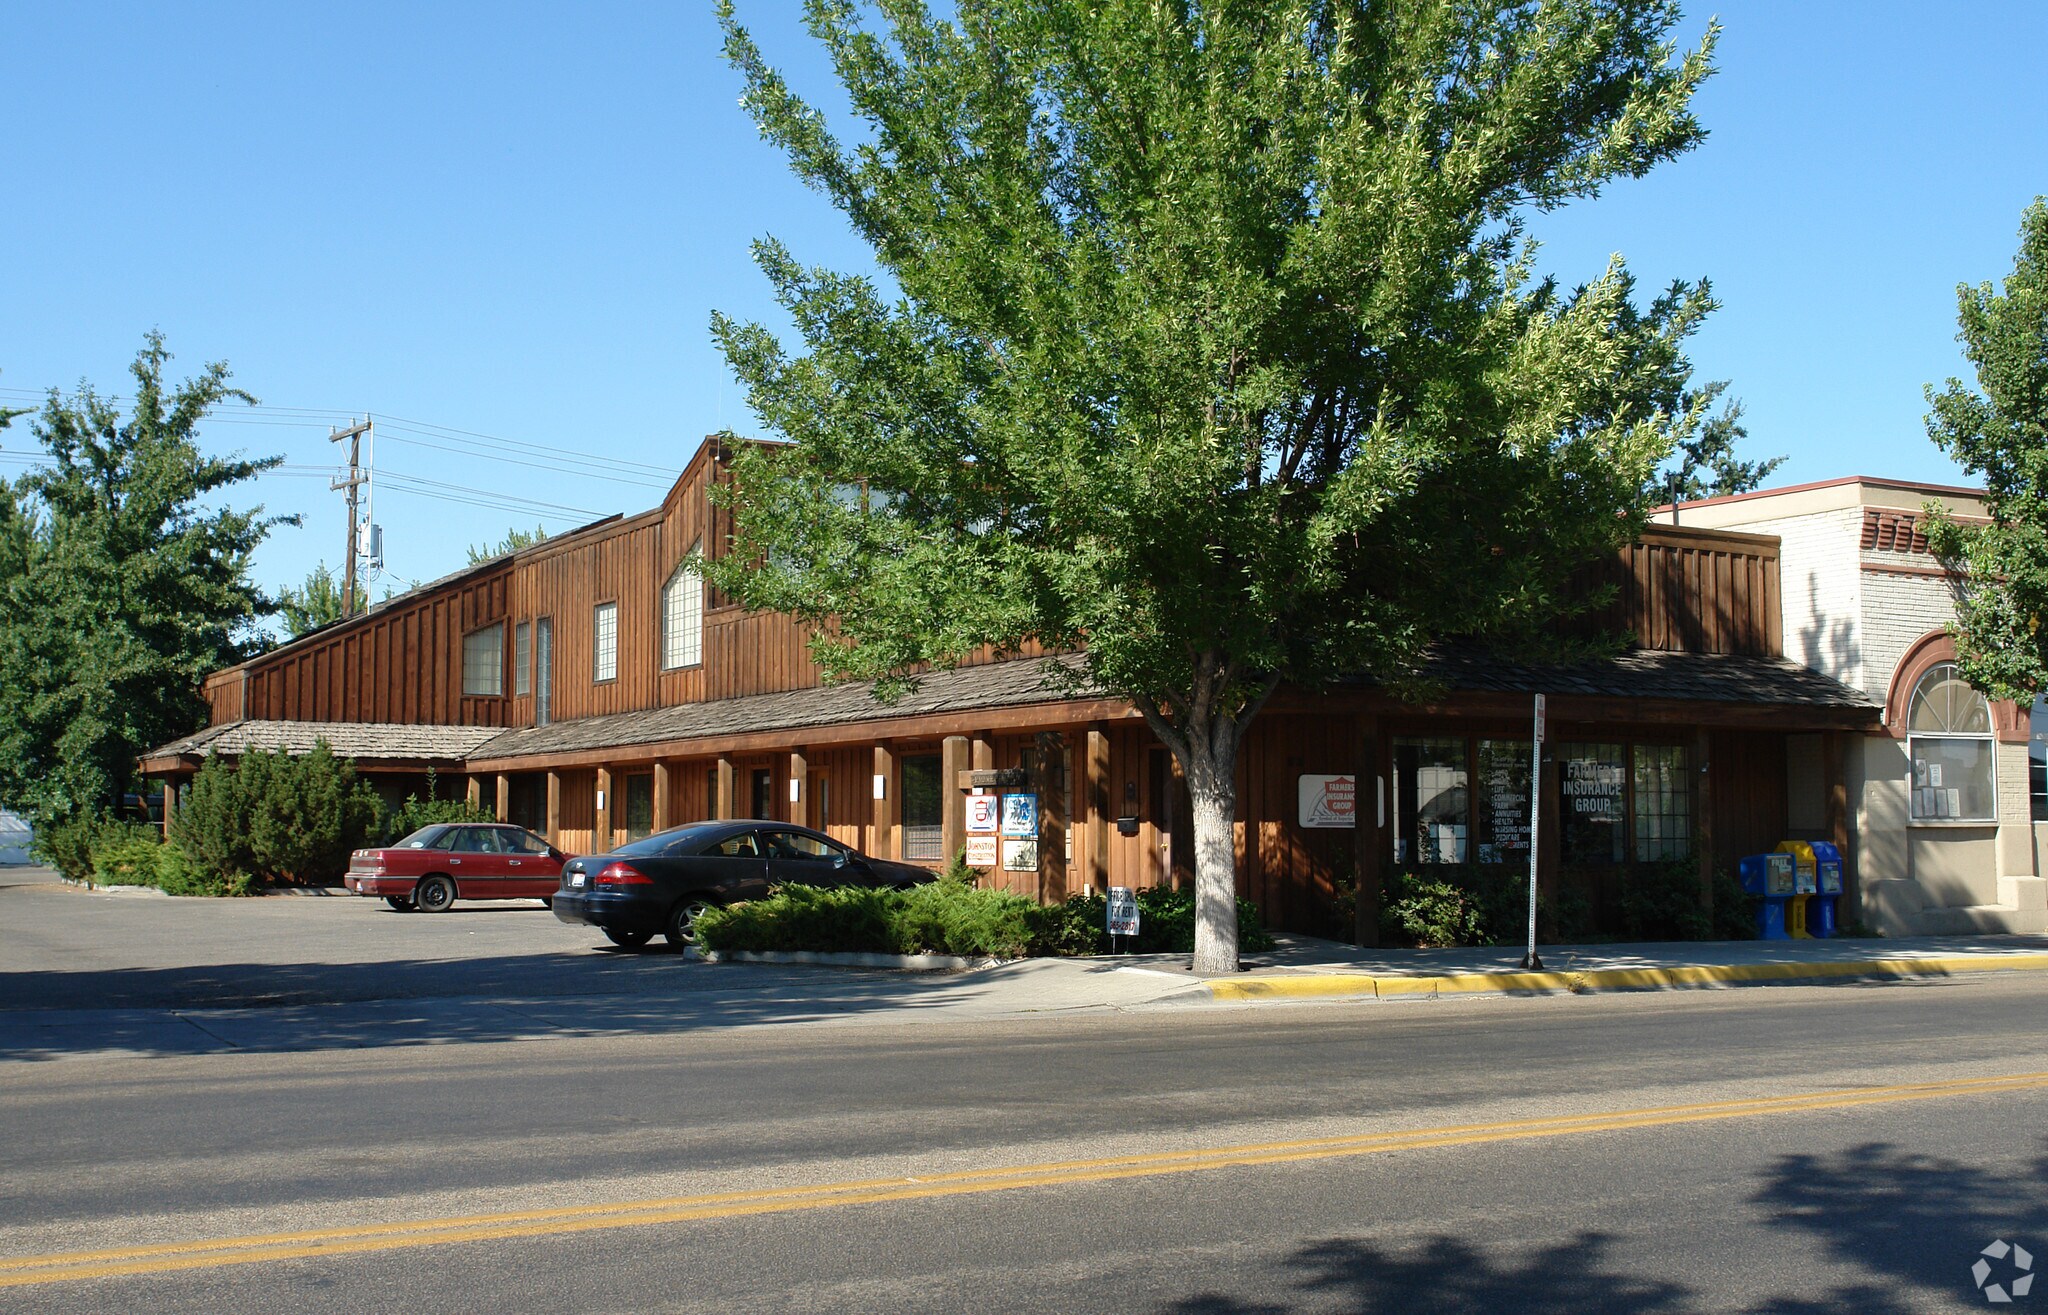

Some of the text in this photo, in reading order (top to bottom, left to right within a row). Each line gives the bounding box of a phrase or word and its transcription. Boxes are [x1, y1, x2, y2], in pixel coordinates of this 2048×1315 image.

[1567, 764, 1617, 780] FARMERS
[1329, 783, 1355, 791] FARMERS
[1494, 785, 1504, 793] LIFE
[1563, 780, 1621, 796] INSURANCE
[1326, 792, 1355, 800] INSURANC
[1493, 794, 1526, 802] COMMERCIAL
[1333, 801, 1352, 809] GROUP
[1575, 798, 1611, 812] GROUP
[1494, 810, 1522, 818] ANNUITIES
[1494, 817, 1514, 826] HEALTH
[1494, 826, 1532, 834] NURSING HOM
[1495, 833, 1520, 842] MEDICARE
[1771, 859, 1788, 867] FREE
[1112, 906, 1133, 917] FOR RENT
